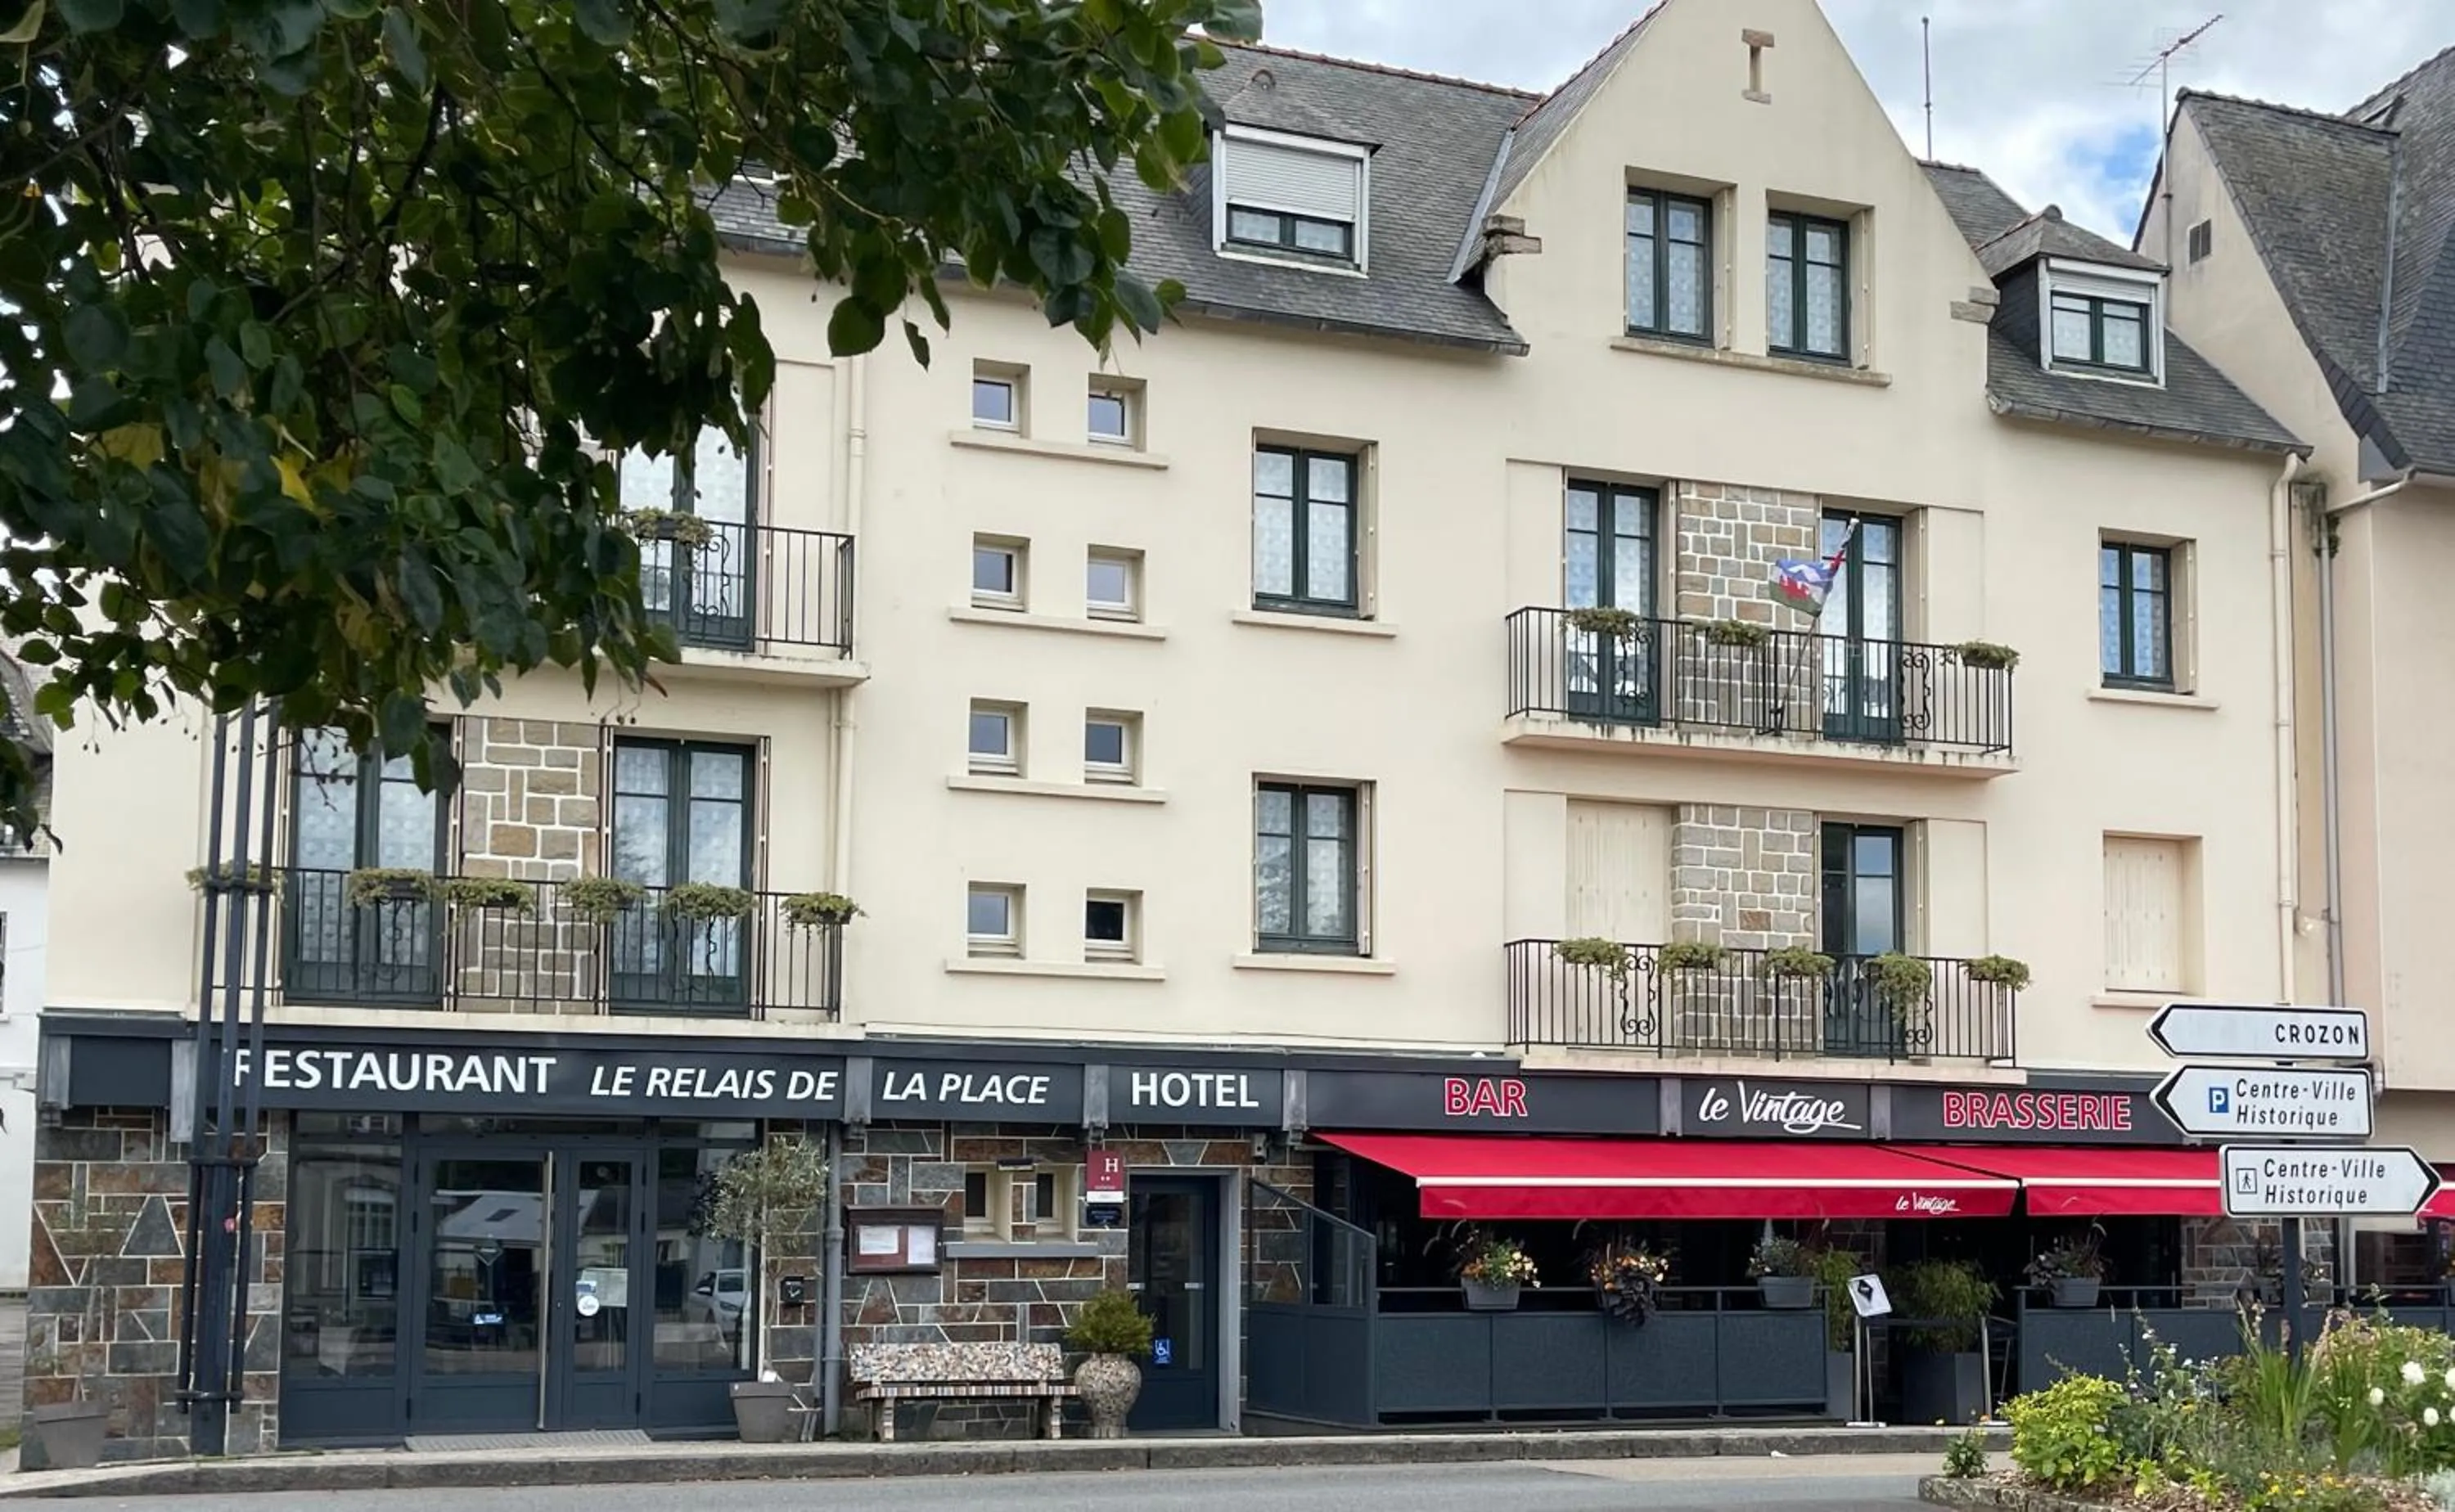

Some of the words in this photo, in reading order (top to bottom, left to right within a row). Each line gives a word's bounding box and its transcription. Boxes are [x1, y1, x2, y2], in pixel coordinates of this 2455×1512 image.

[2275, 1024, 2360, 1045] CROZON
[590, 1066, 637, 1096] LE
[646, 1067, 777, 1100] RELAIS
[786, 1071, 839, 1100] DE
[882, 1071, 928, 1101] LA
[939, 1073, 1051, 1104] PLACE
[1131, 1072, 1259, 1108] HOTEL
[1444, 1078, 1528, 1117] BAR
[2237, 1078, 2357, 1100] Centre-Ville
[1737, 1081, 1863, 1134] Vintage
[1943, 1091, 2133, 1130] BRASSERIE
[2212, 1091, 2226, 1111] P
[2237, 1105, 2339, 1130] Historique
[1105, 1158, 1119, 1172] H
[2264, 1158, 2385, 1179] Centre-Ville
[2264, 1184, 2368, 1209] Historique
